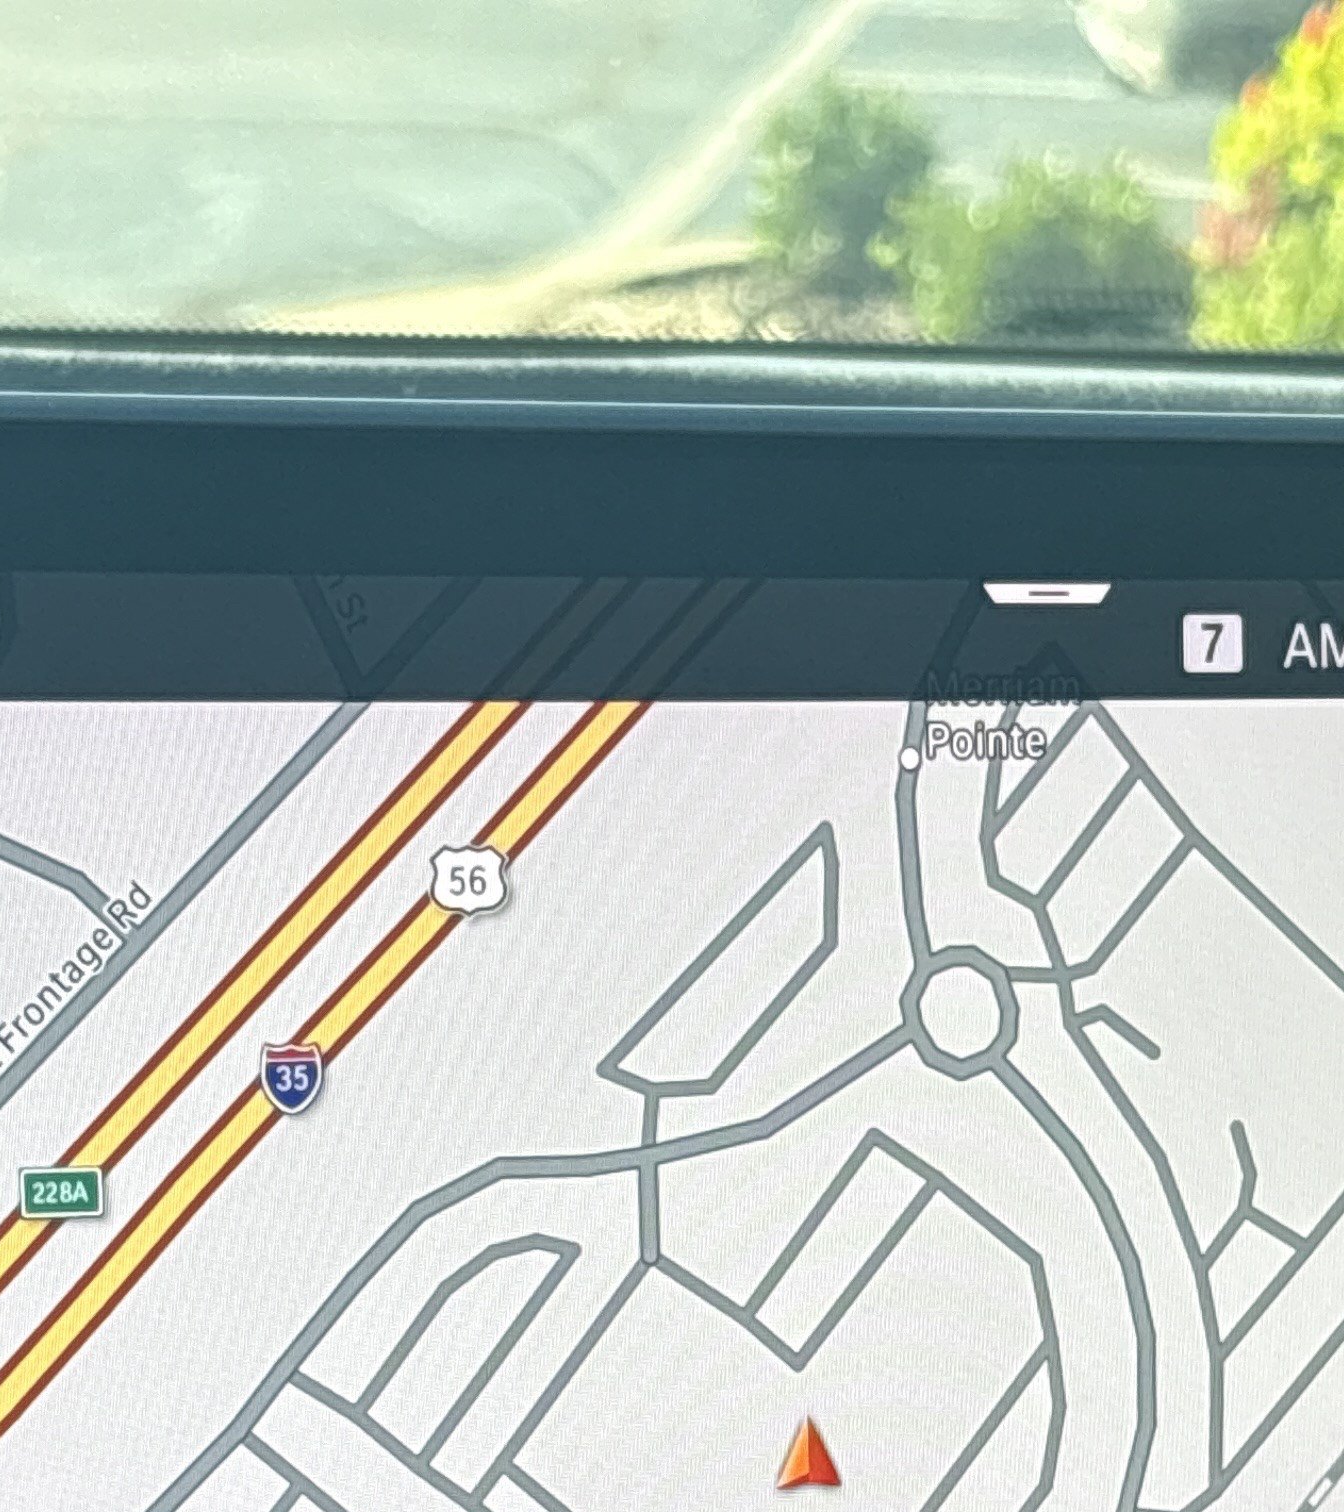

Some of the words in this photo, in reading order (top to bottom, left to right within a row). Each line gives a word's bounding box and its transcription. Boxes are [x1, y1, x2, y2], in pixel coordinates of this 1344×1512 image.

[1200, 622, 1224, 664] 7
[925, 720, 1048, 761] Pointe
[449, 865, 487, 897] 56
[106, 879, 153, 929] Rd
[274, 1063, 310, 1092] 35
[31, 1180, 89, 1205] 228A
